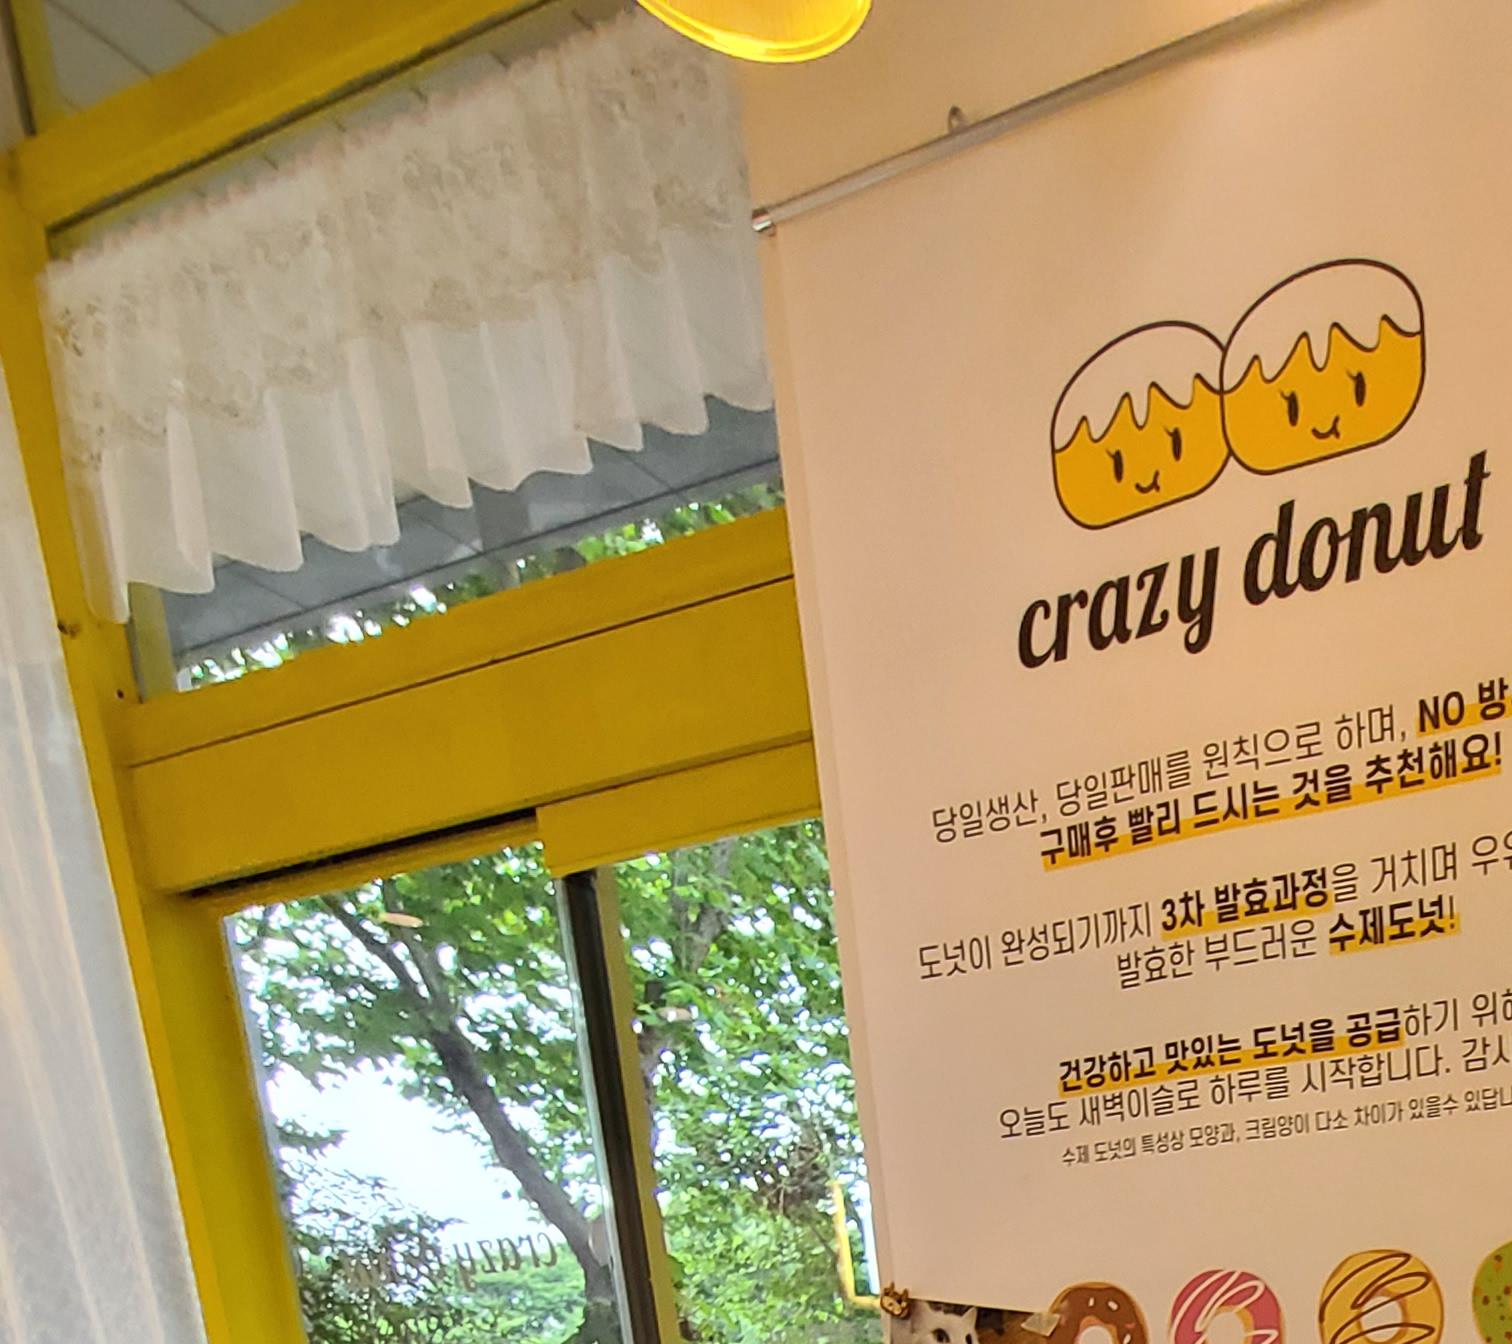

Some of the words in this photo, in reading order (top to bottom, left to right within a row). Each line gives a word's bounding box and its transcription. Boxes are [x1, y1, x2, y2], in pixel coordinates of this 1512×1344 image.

[1016, 545, 1221, 669] crazy
[1243, 449, 1492, 607] donut
[931, 788, 1048, 844] 당일생산,
[1056, 749, 1193, 817] 당일판매를
[1202, 722, 1323, 781] 원칙으로
[1334, 703, 1408, 752] 하며,
[1418, 690, 1466, 733] NO
[1039, 815, 1120, 866] 구매후
[1128, 797, 1181, 846] 빨리
[1192, 781, 1281, 829] 드시는
[1292, 763, 1353, 811] 것을
[1364, 731, 1503, 794] 추천해요!
[918, 934, 993, 981] 도넛이
[1000, 901, 1153, 968] 완성되기까지
[1160, 889, 1205, 932] 3차
[1213, 861, 1360, 925] 발효과정을
[1370, 841, 1459, 895] 거치며
[1116, 941, 1196, 990] 발효한
[1203, 918, 1319, 973] 부드러운
[1328, 893, 1457, 953] 수제도넛!
[998, 1100, 1072, 1140] 오늘도
[1078, 1078, 1209, 1128] 새벽이슬로
[1208, 1065, 1291, 1107] 하루를
[1300, 1043, 1452, 1095] 시작합니다.
[1059, 1045, 1158, 1094] 건강하고
[1163, 1032, 1243, 1075] 맛있는
[1251, 1017, 1336, 1060] 도넛을
[1345, 998, 1460, 1050] 공급하기
[1060, 1142, 1091, 1168] 수제
[1093, 1135, 1138, 1164] 도넛의
[1140, 1128, 1186, 1157] 특성상
[1314, 1109, 1350, 1133] 다소
[1353, 1100, 1406, 1129] 차이가
